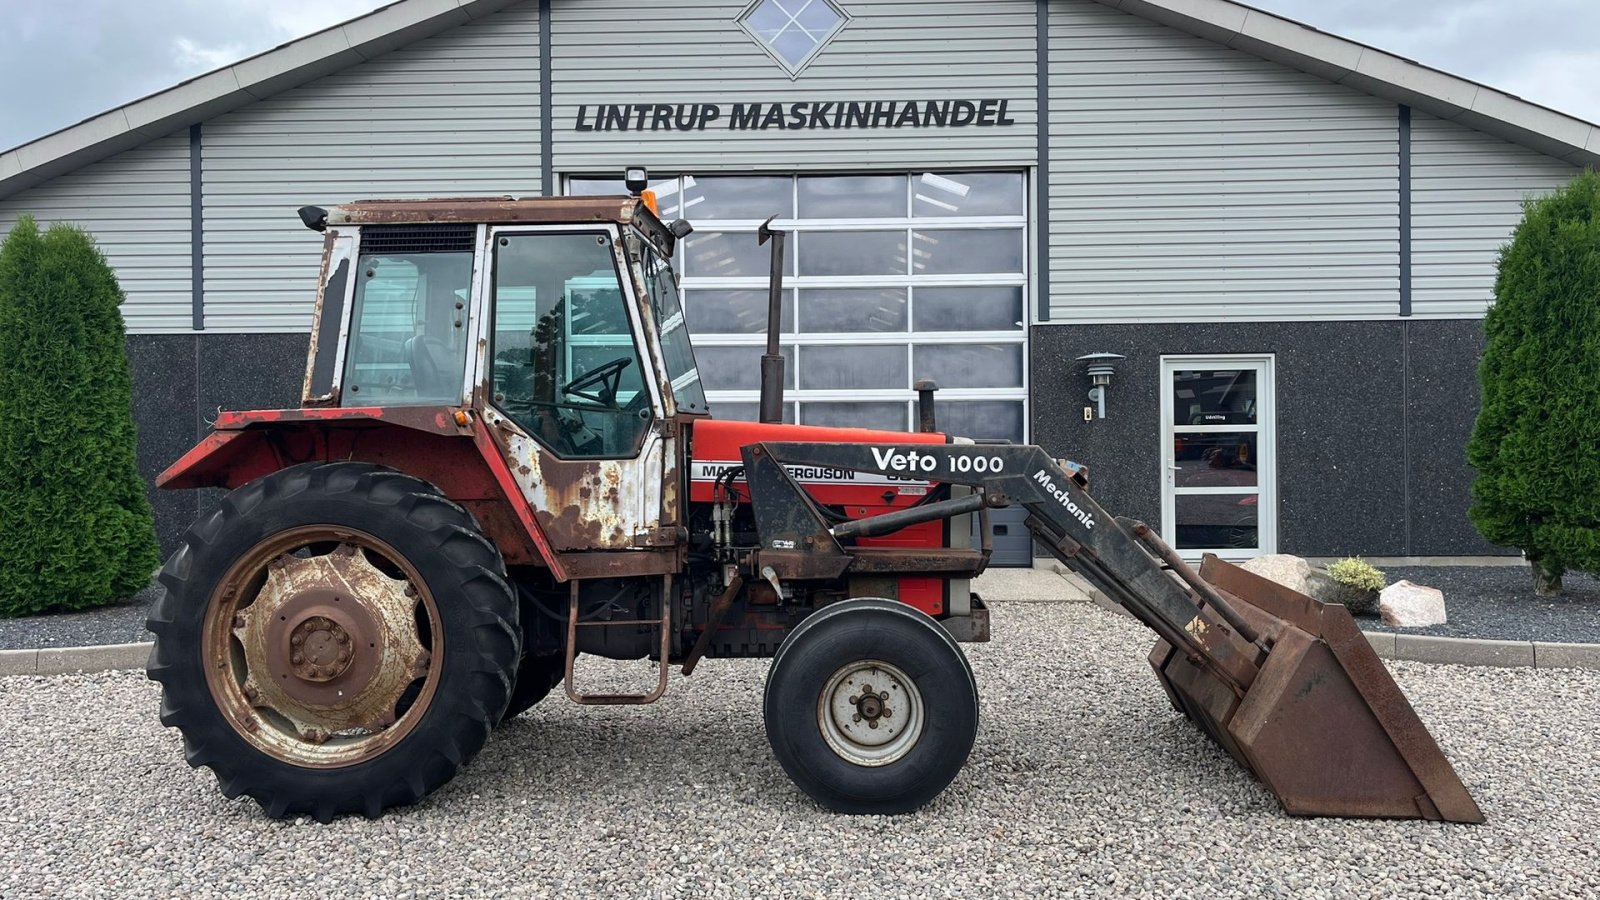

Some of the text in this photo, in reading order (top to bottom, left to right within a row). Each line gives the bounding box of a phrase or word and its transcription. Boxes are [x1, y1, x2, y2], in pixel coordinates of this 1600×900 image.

[575, 99, 1015, 132] LINTRUP MASKINHANDEL
[871, 447, 1004, 473] Veto 1000
[1033, 469, 1096, 530] Mechanic
